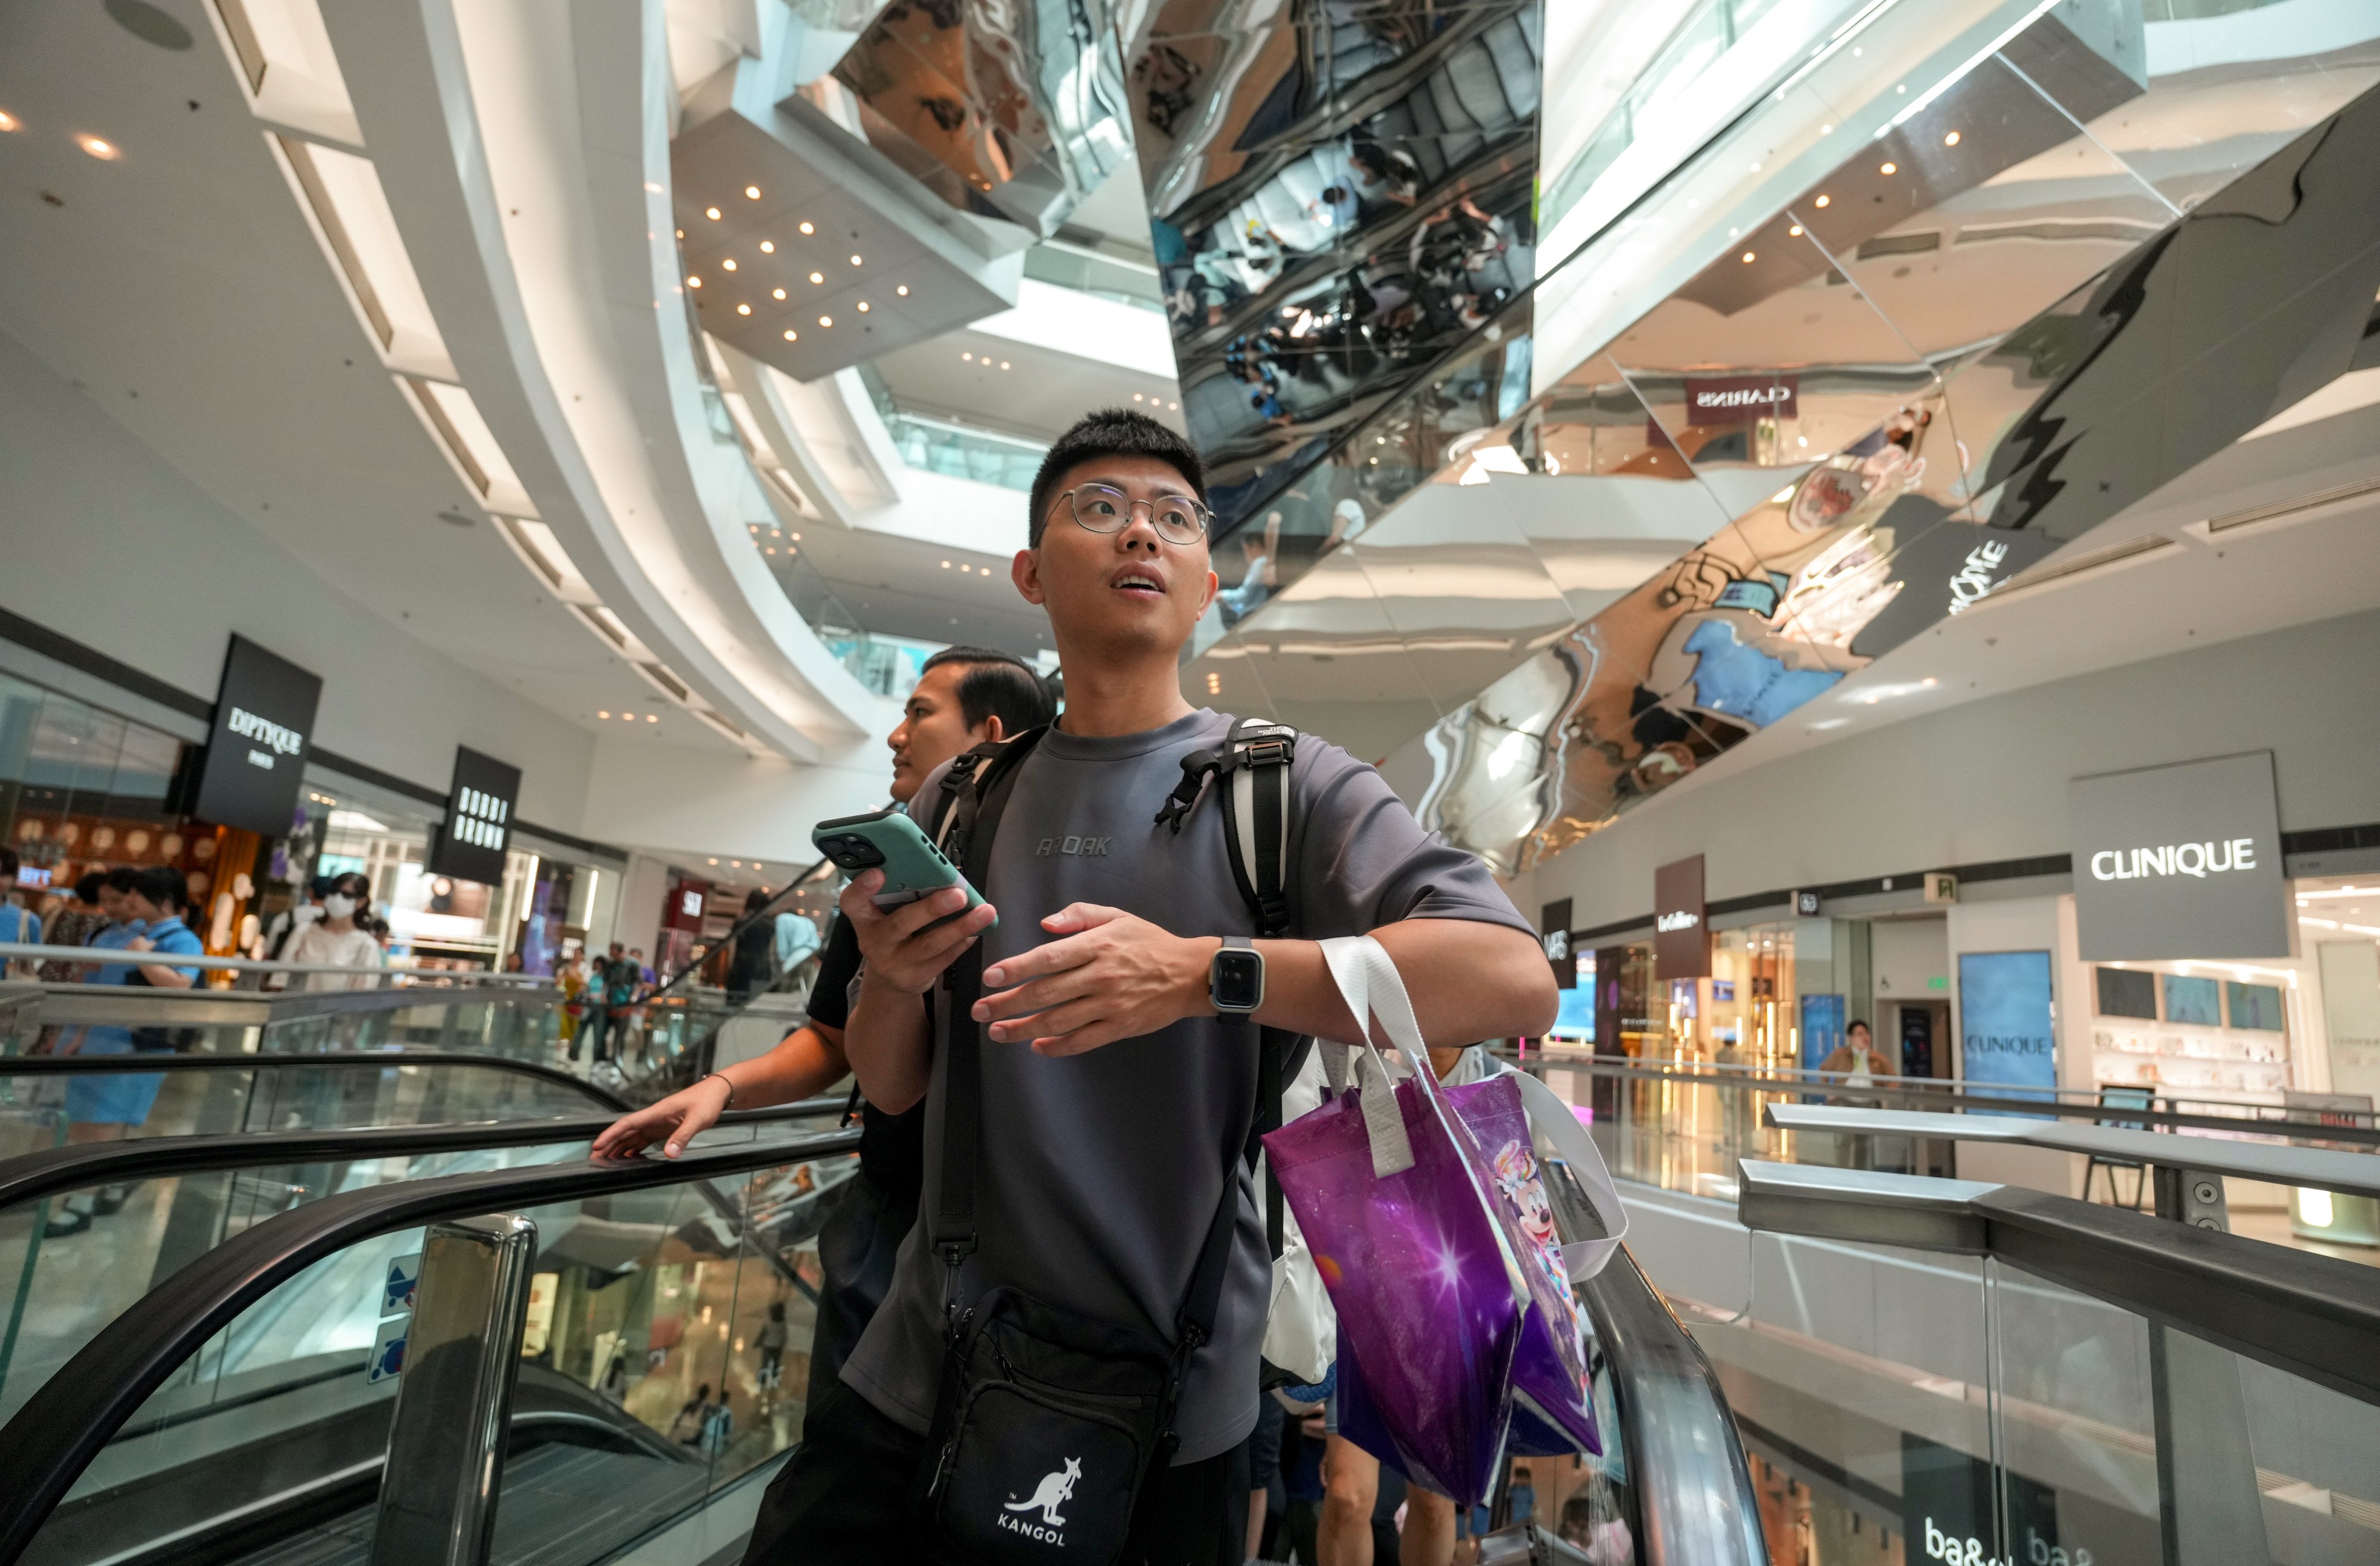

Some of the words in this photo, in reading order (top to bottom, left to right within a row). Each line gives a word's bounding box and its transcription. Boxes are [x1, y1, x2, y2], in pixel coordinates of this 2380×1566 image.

[227, 707, 302, 755] DIPTYQUE
[2091, 838, 2257, 881] CLINIQUE
[1967, 1034, 2049, 1058] CLINIQUE
[997, 1513, 1065, 1547] KANGOL
